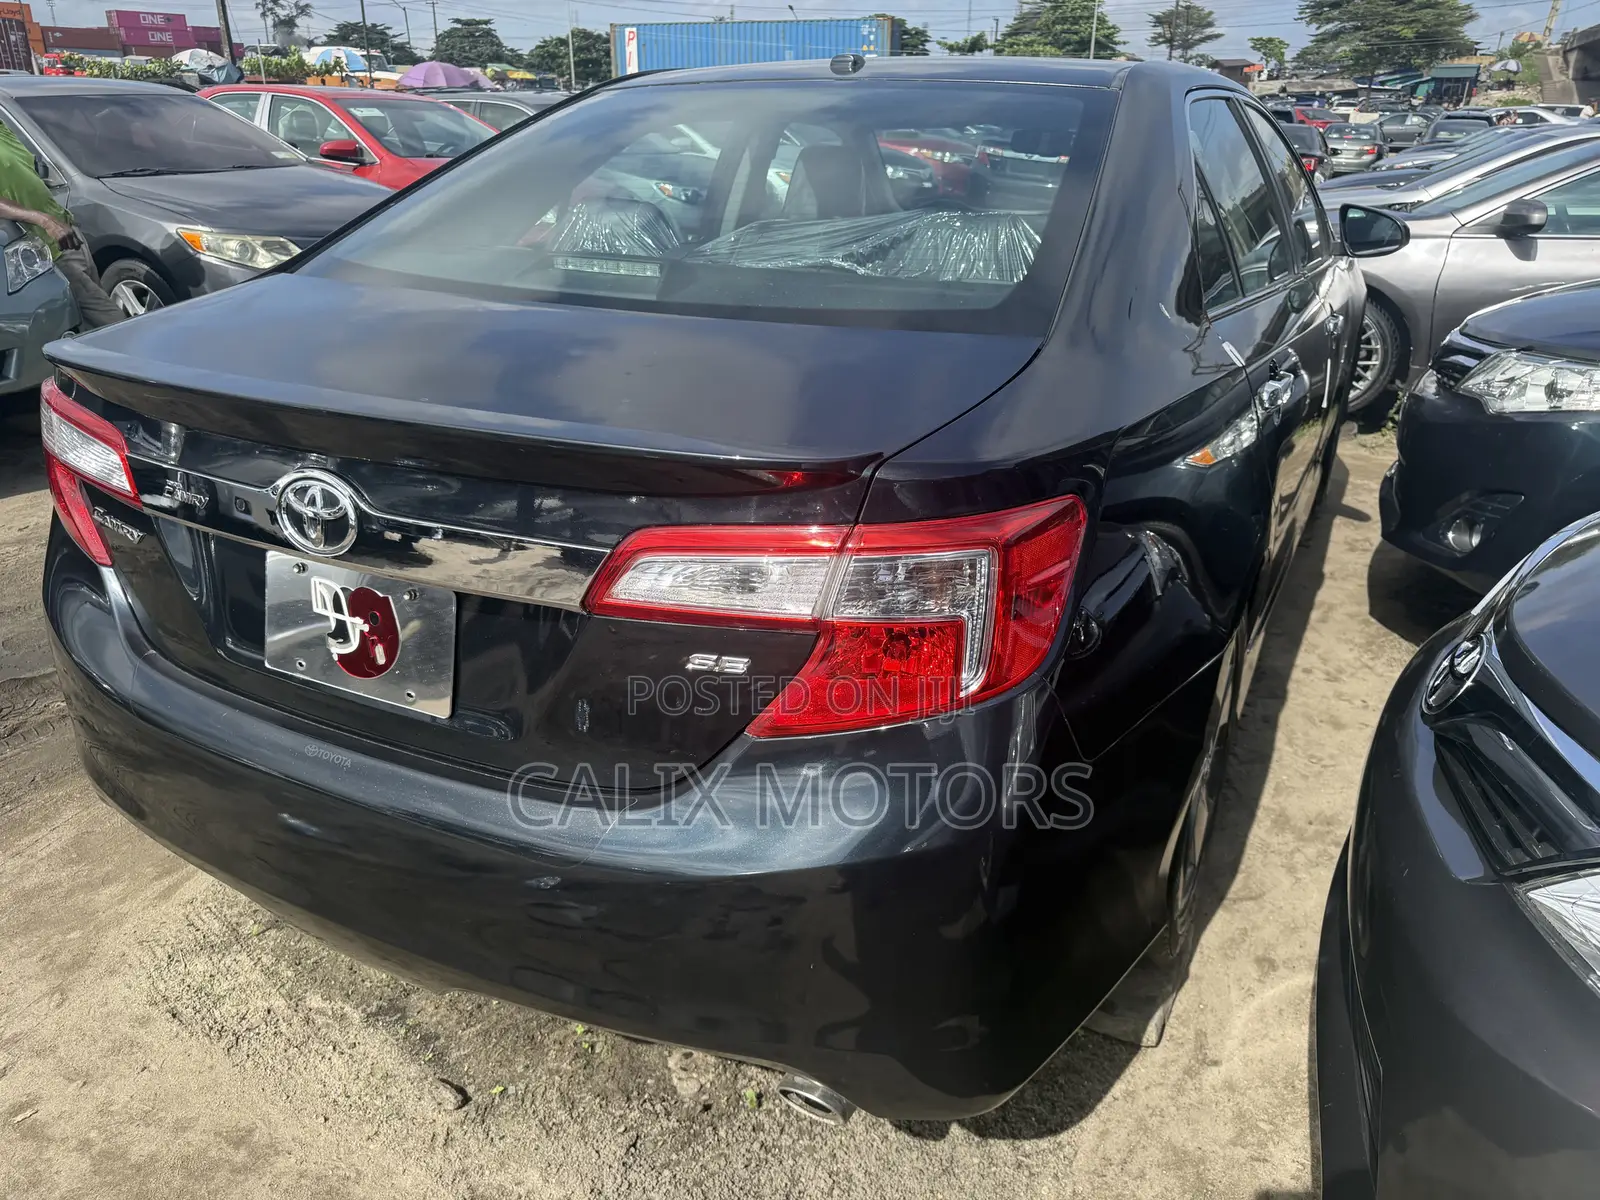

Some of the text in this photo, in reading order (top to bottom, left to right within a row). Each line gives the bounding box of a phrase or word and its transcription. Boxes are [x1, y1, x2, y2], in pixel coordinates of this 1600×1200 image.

[140, 13, 165, 24] ONE
[148, 31, 173, 42] ONE
[93, 506, 147, 544] CAMRY
[318, 748, 351, 768] TOYOTA
